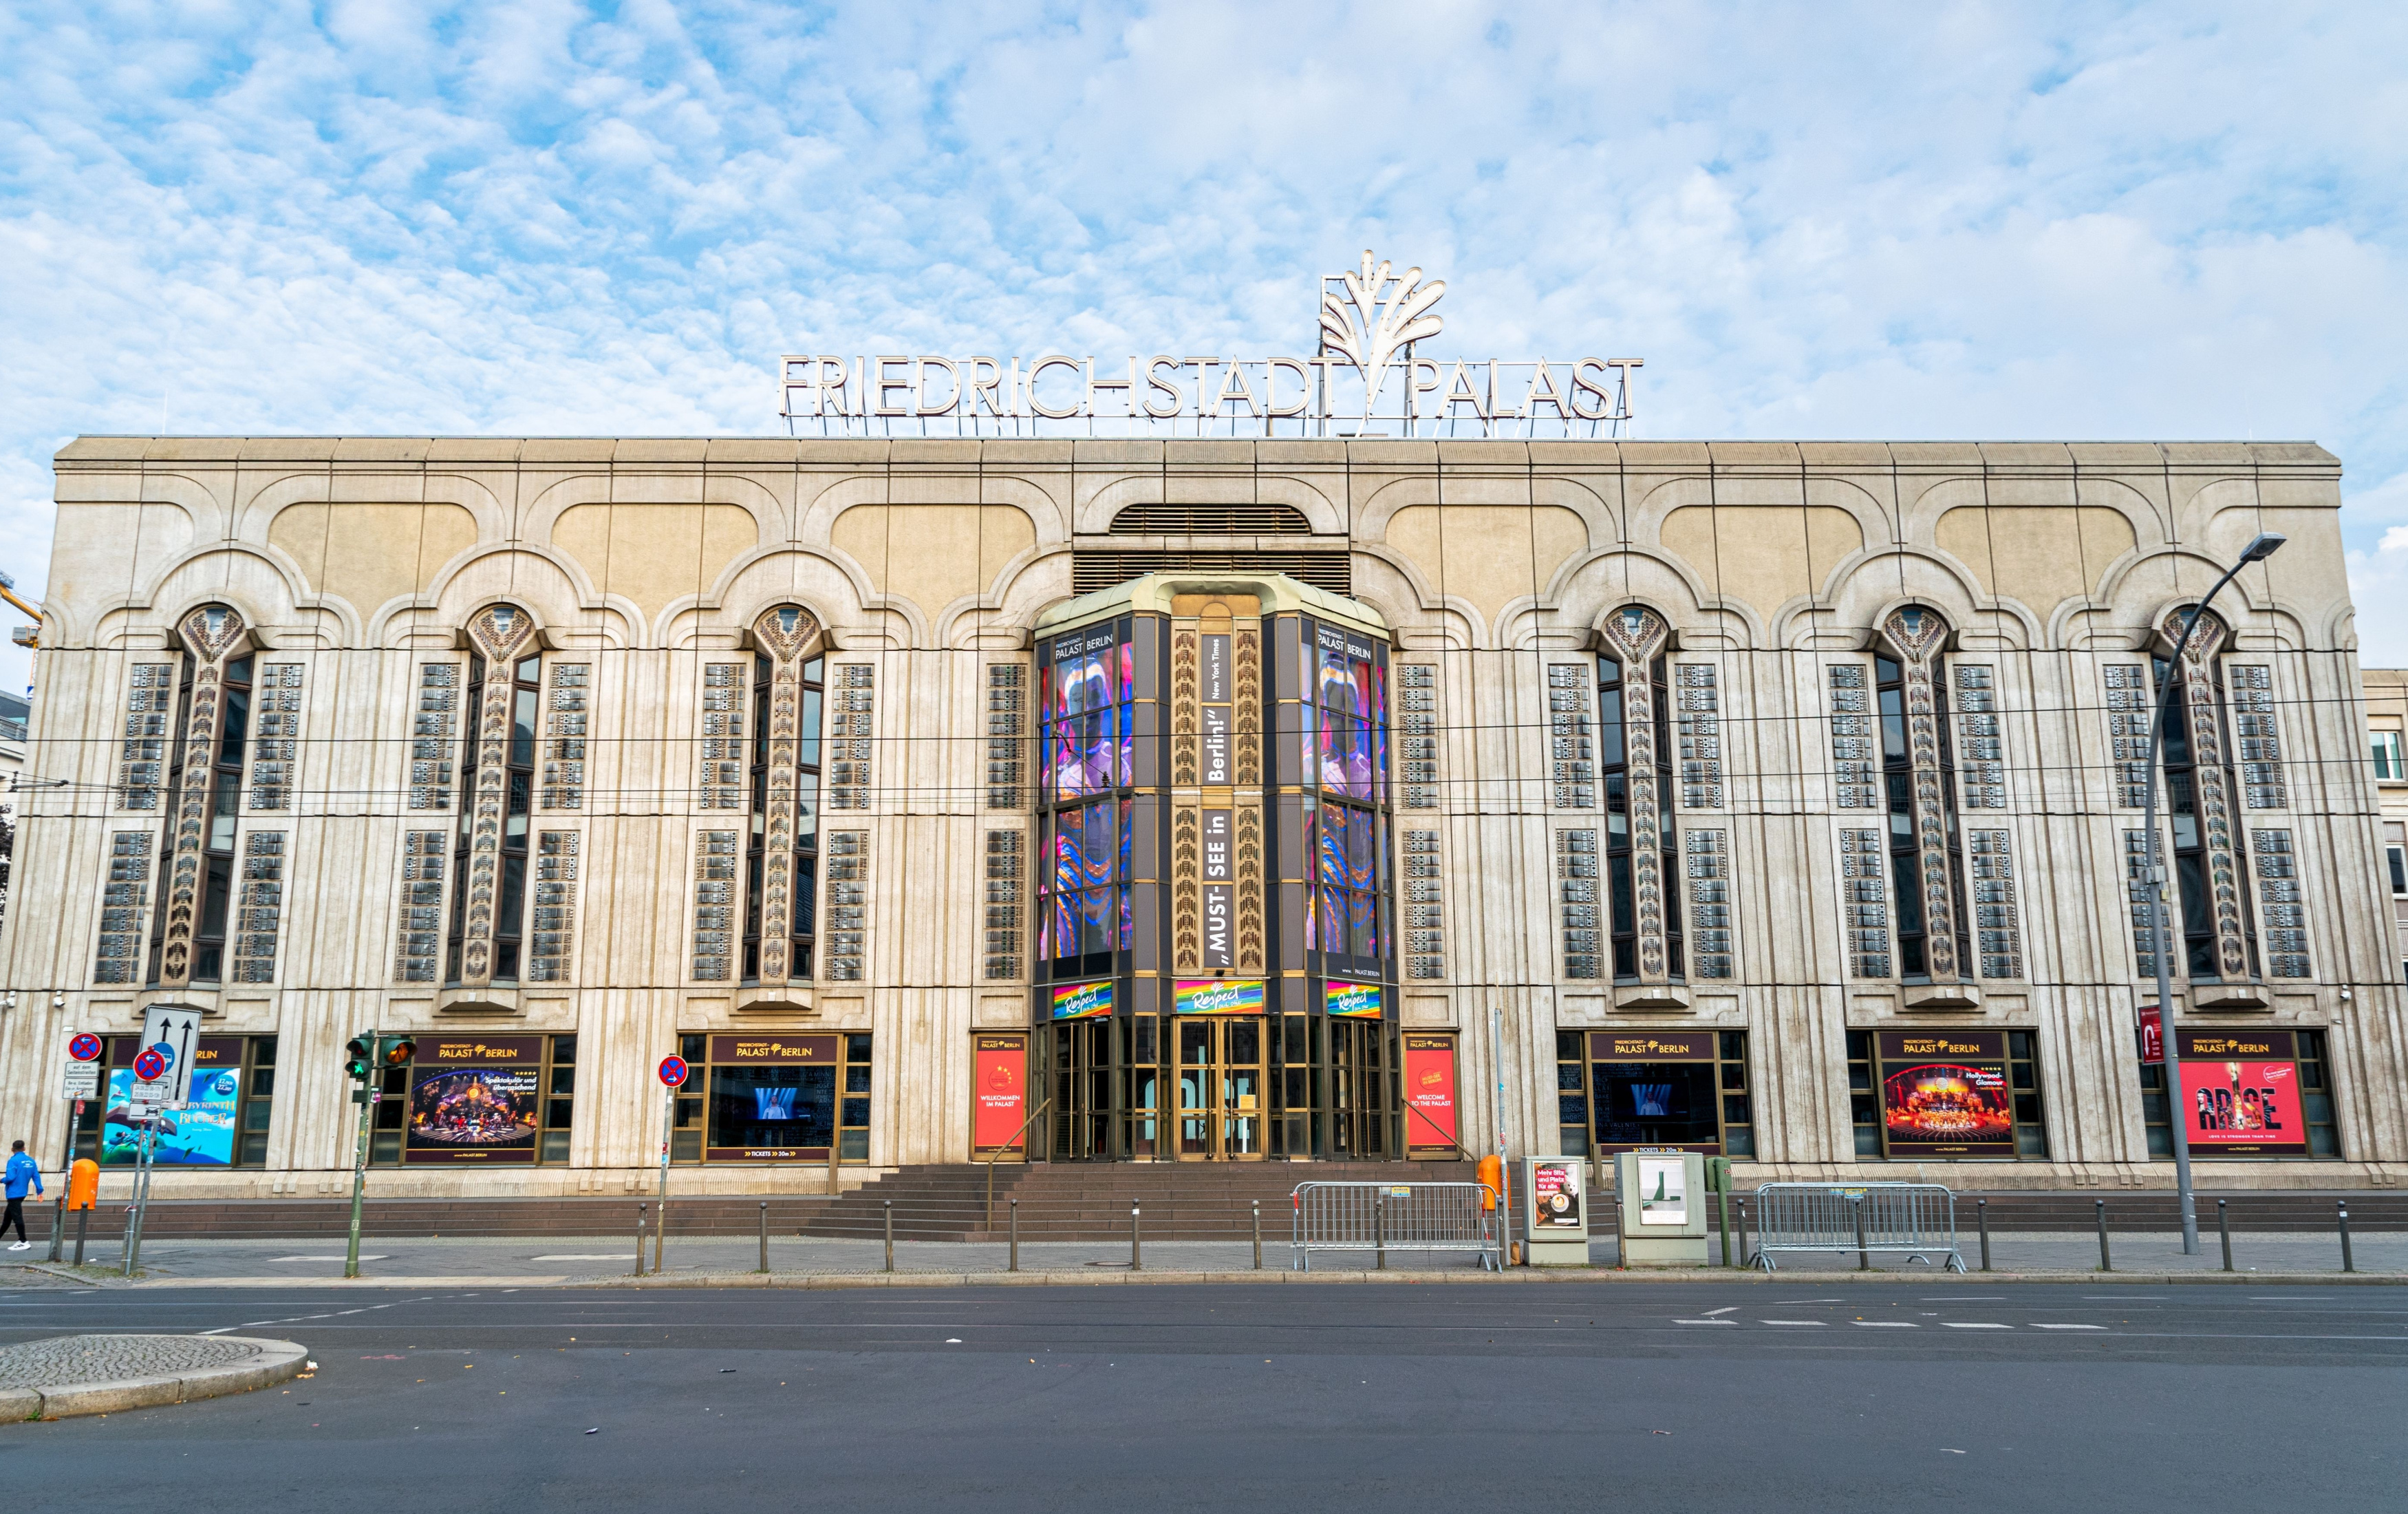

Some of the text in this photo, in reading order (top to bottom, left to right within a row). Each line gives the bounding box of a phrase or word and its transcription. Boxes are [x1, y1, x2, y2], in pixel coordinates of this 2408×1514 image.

[779, 355, 1644, 419] FRIEDRICHSTADT PALAST
[1055, 634, 1112, 659] PALAST BERLIN
[1318, 634, 1370, 659] PALAST BERLIN
[1206, 816, 1225, 834] in
[1207, 842, 1225, 877] SEE
[1065, 985, 1101, 1013] Respect
[1192, 983, 1245, 1010] Respect
[1337, 988, 1370, 1012] Respect
[439, 1049, 517, 1058] PALAST BERLIN
[736, 1048, 812, 1056] PALAST BERLIN
[1615, 1045, 1688, 1053] PALAST BERLIN
[1904, 1045, 1979, 1053] PALAST BERLIN
[485, 1076, 524, 1085] Spektakulär
[1966, 1071, 2003, 1080] Hollywood-
[2195, 1063, 2282, 1131] ARISE
